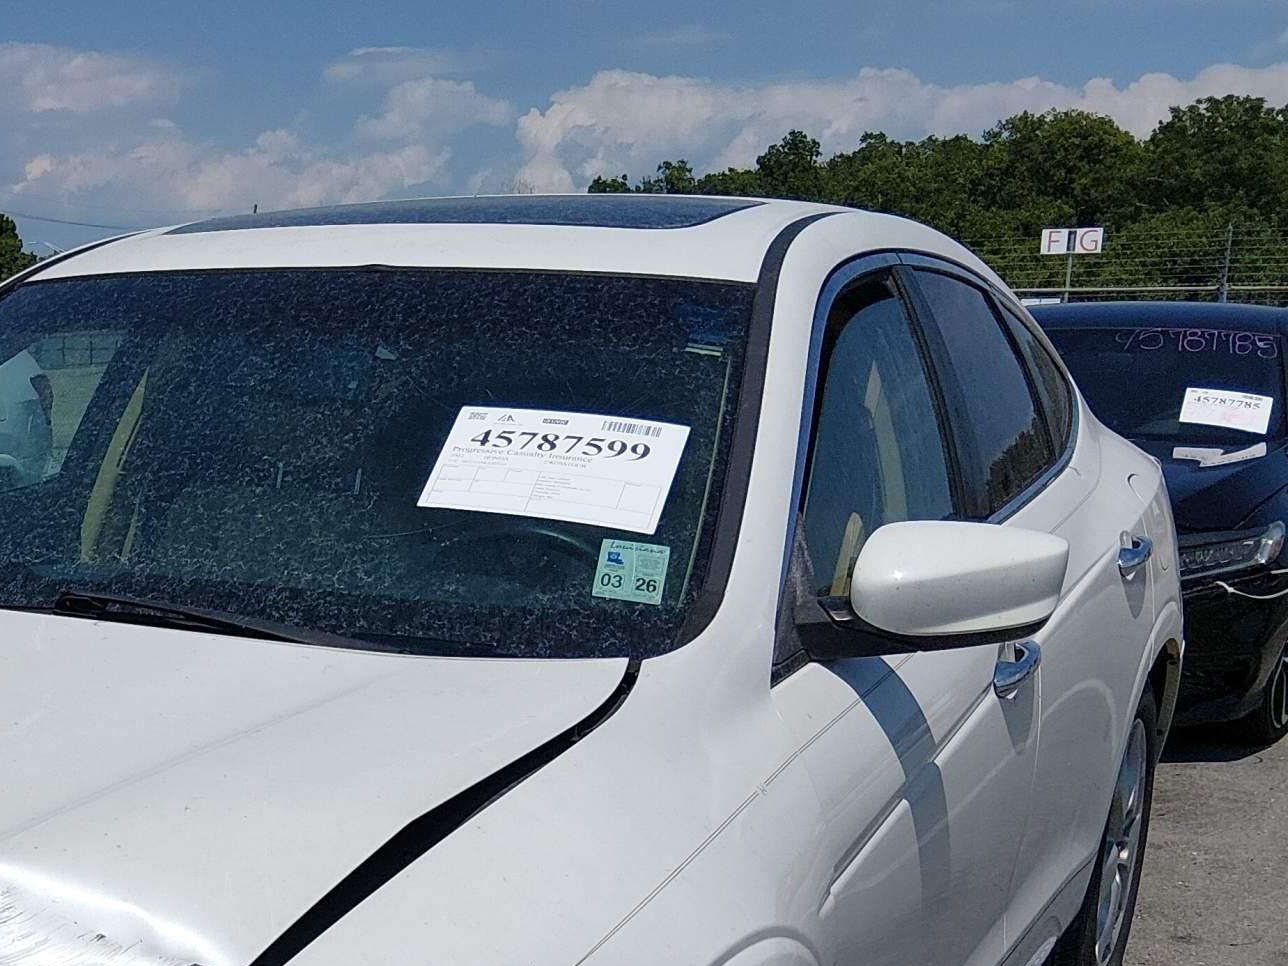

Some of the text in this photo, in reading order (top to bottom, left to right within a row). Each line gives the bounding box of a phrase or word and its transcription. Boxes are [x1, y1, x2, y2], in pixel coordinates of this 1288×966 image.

[1193, 395, 1262, 410] 45787785
[470, 428, 652, 462] 45787599
[507, 449, 545, 459] Casualty
[549, 453, 592, 463] Insurance
[610, 541, 667, 554] Louisiana
[600, 573, 623, 588] 03
[635, 577, 658, 593] 26
